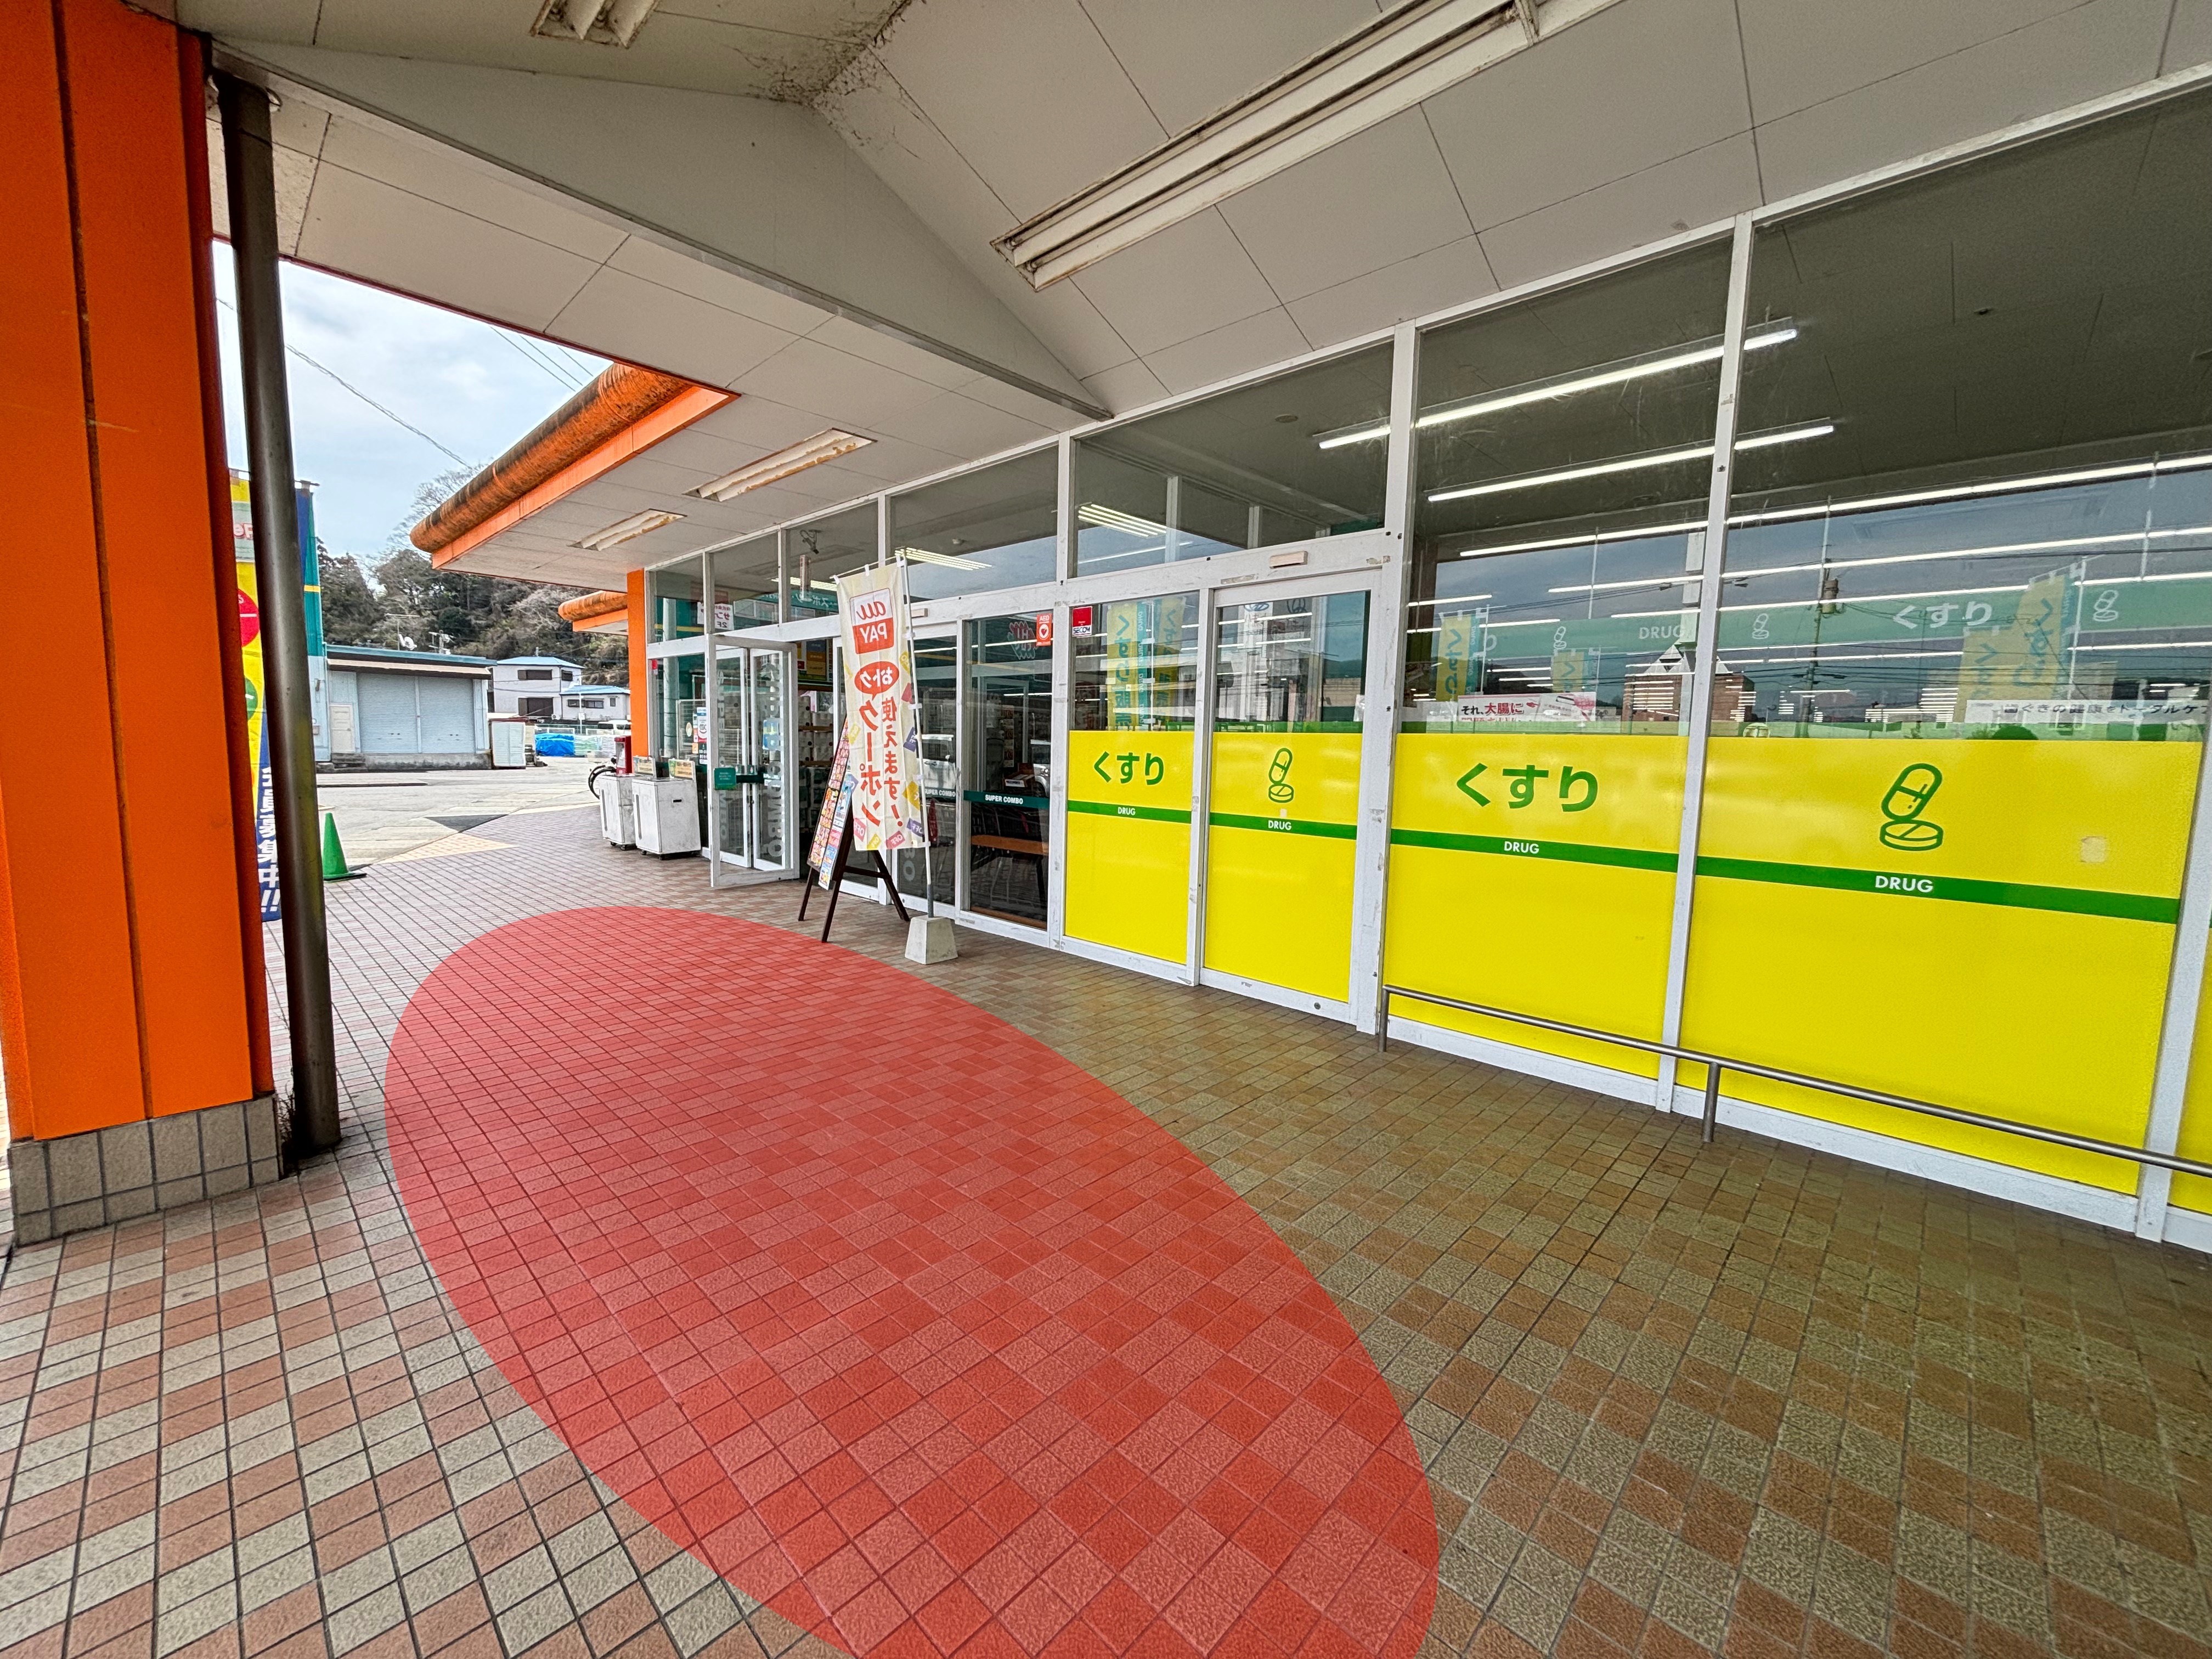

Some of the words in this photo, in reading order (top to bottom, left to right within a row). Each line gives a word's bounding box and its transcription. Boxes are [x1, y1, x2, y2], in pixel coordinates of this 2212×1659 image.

[1893, 601, 1992, 629] くすり
[1639, 624, 1687, 640] DRUG
[1462, 702, 1523, 715] それ、大腸に
[1094, 751, 1164, 786] くすり
[1457, 763, 1598, 812] くすり
[985, 794, 1002, 802] SUPER
[1003, 796, 1024, 805] COMBO
[1118, 807, 1136, 816] DRUG
[1268, 820, 1292, 831] DRUG
[1504, 841, 1539, 854] DRUG
[1875, 876, 1934, 893] DRUG
